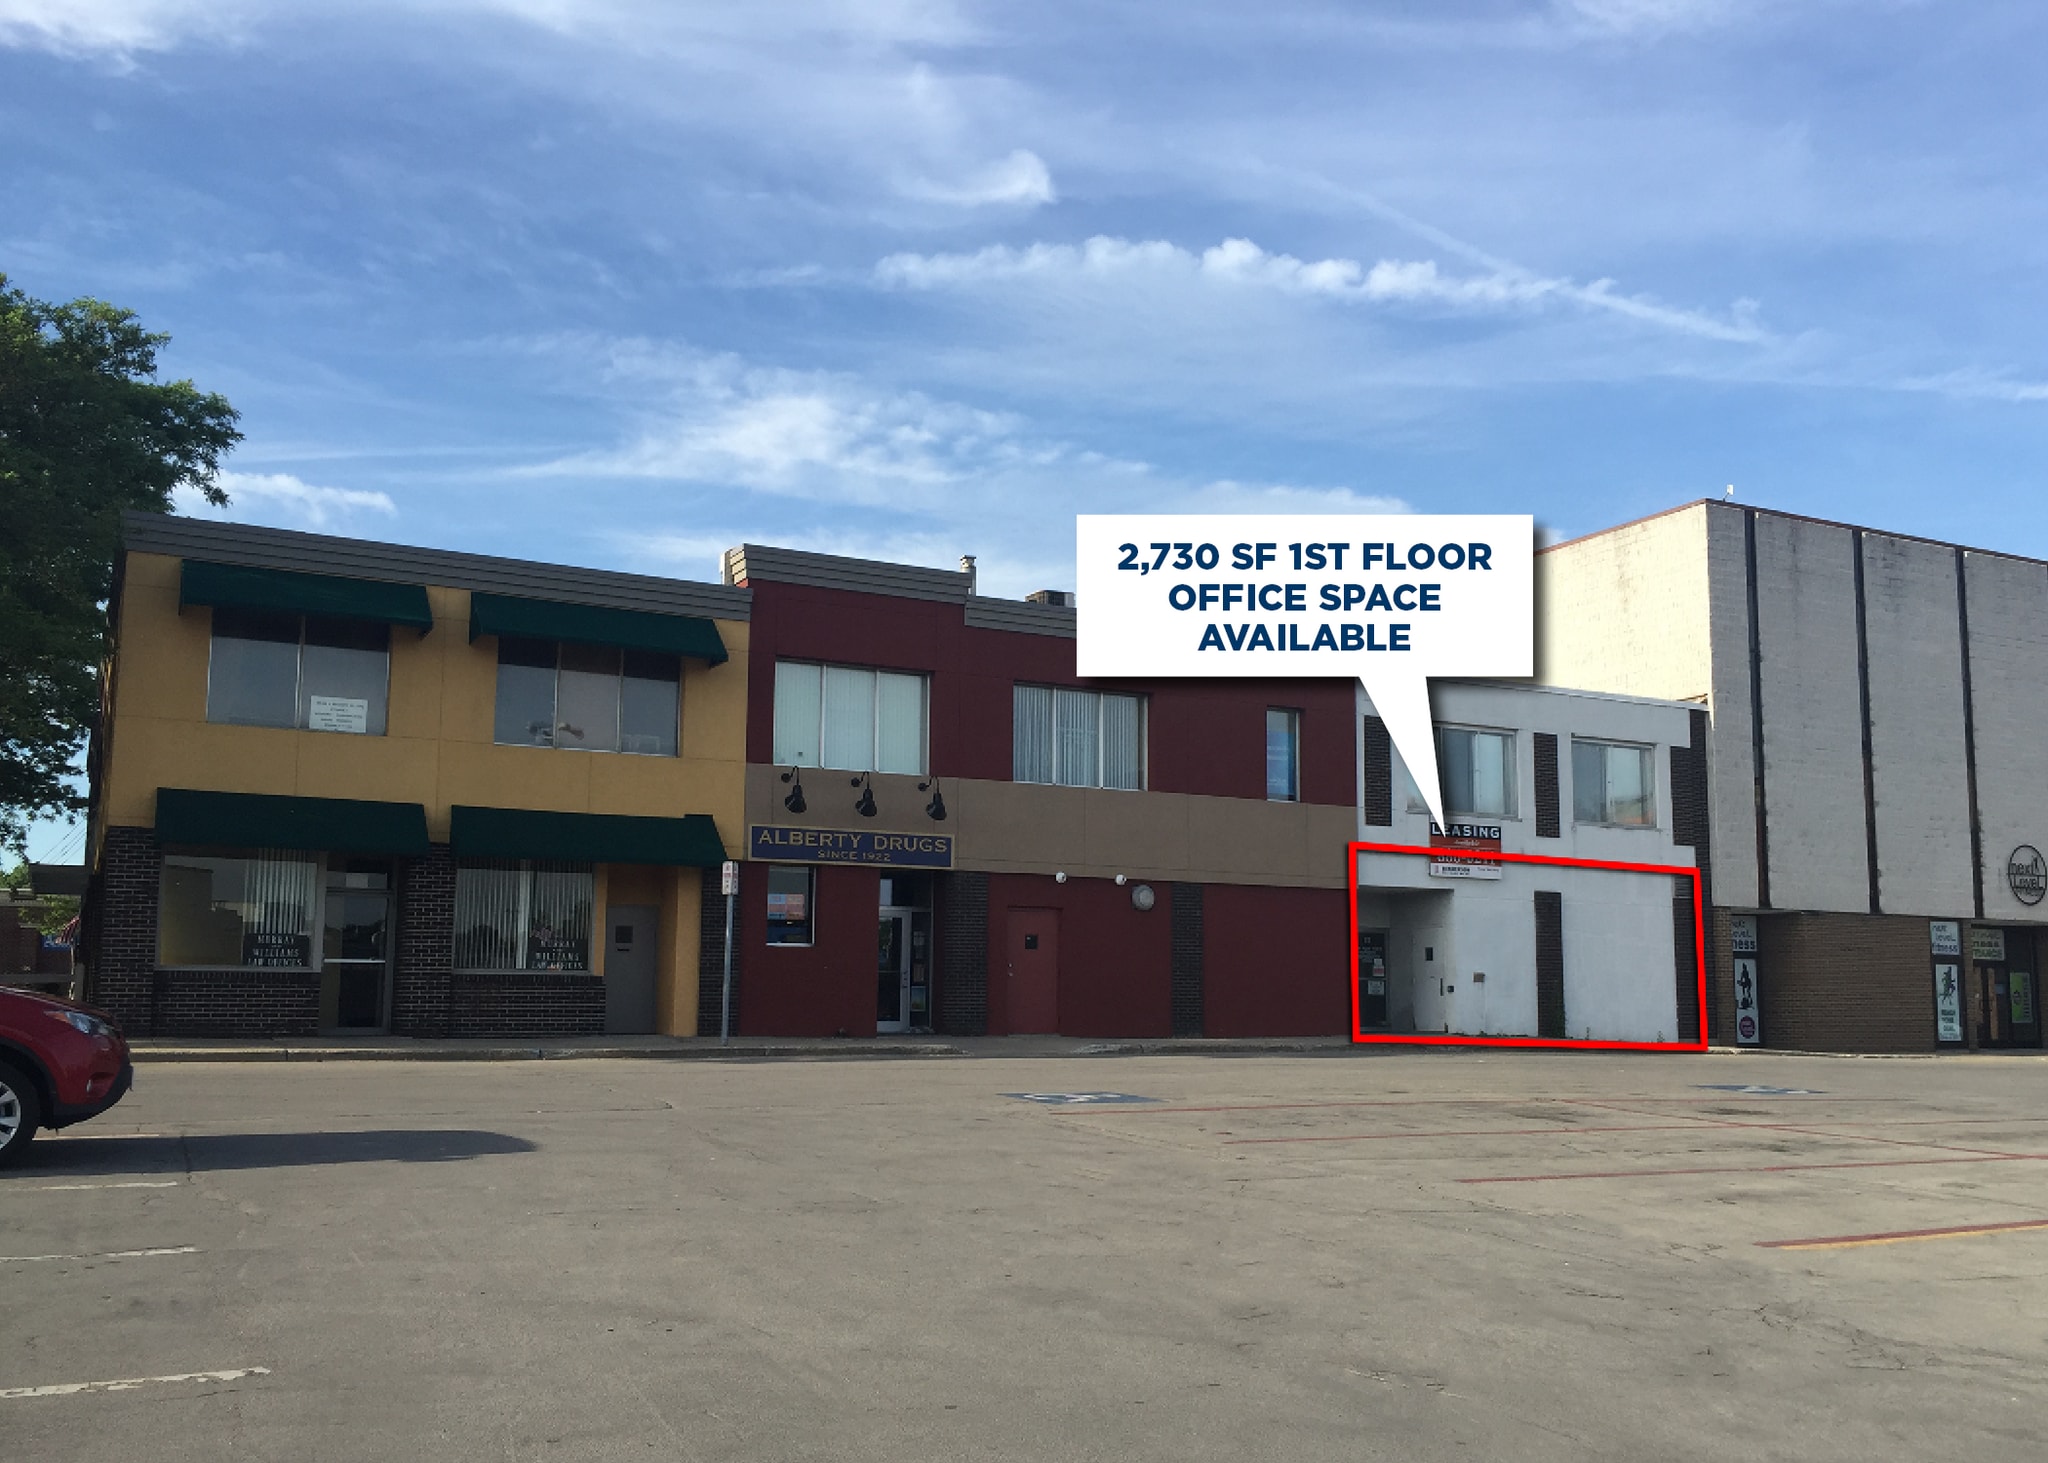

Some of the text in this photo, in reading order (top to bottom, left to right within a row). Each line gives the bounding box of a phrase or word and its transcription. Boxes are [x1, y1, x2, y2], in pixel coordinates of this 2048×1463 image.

[758, 829, 948, 853] ALBERTY DRUGS
[817, 850, 891, 862] SINCE 1922
[257, 935, 296, 944] MURRAY
[1733, 940, 1756, 950] ness
[252, 948, 300, 958] WILLIAMS
[535, 952, 580, 961] WILLIAMS
